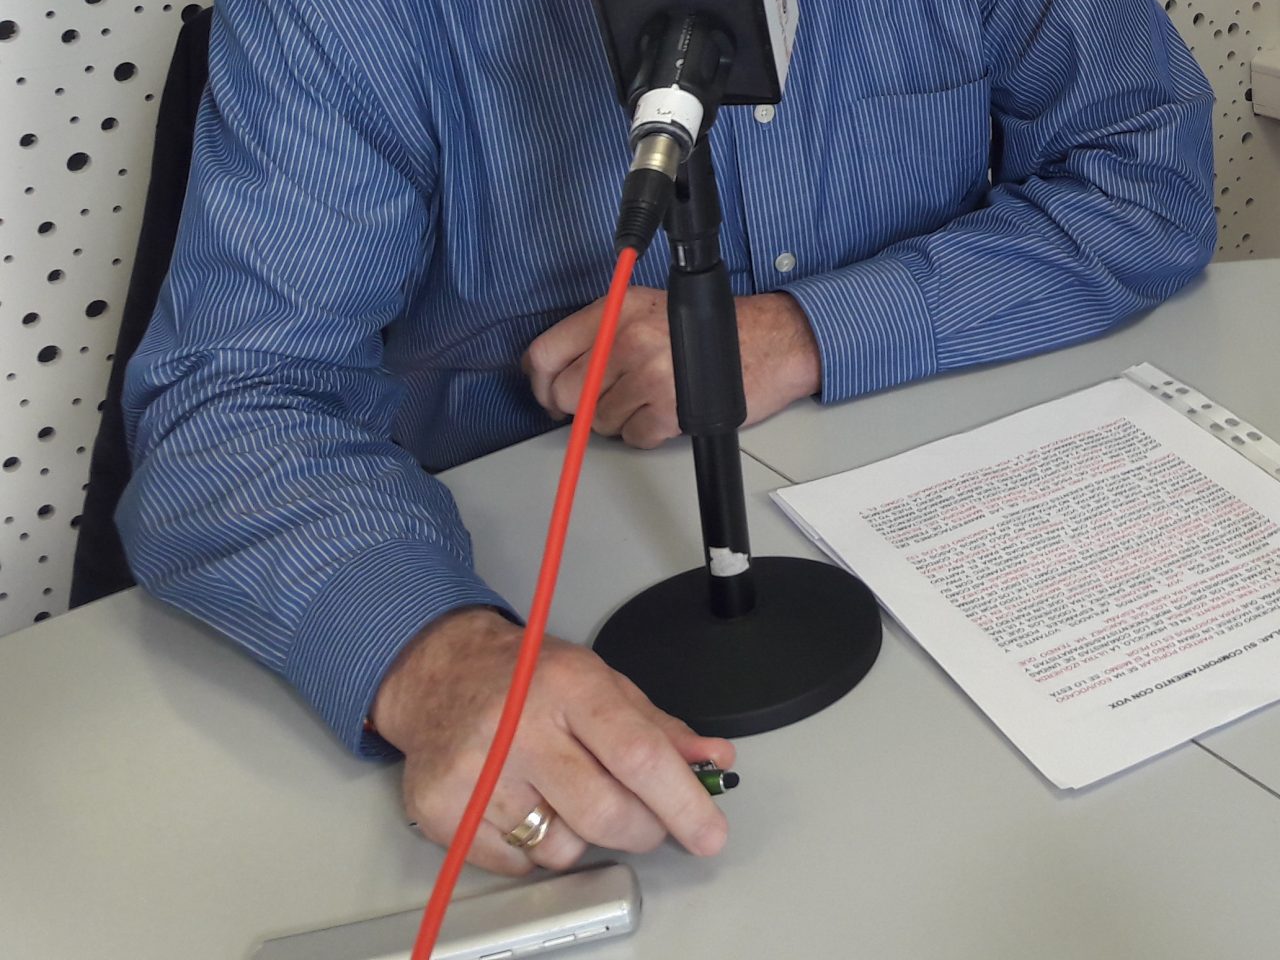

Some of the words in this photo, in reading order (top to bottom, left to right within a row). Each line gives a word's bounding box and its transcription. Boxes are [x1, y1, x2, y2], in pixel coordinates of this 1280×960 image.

[1241, 641, 1258, 651] SU
[1152, 647, 1244, 690] COMPORTAMIENTO
[1129, 686, 1155, 700] CON
[1106, 696, 1132, 710] VOX
